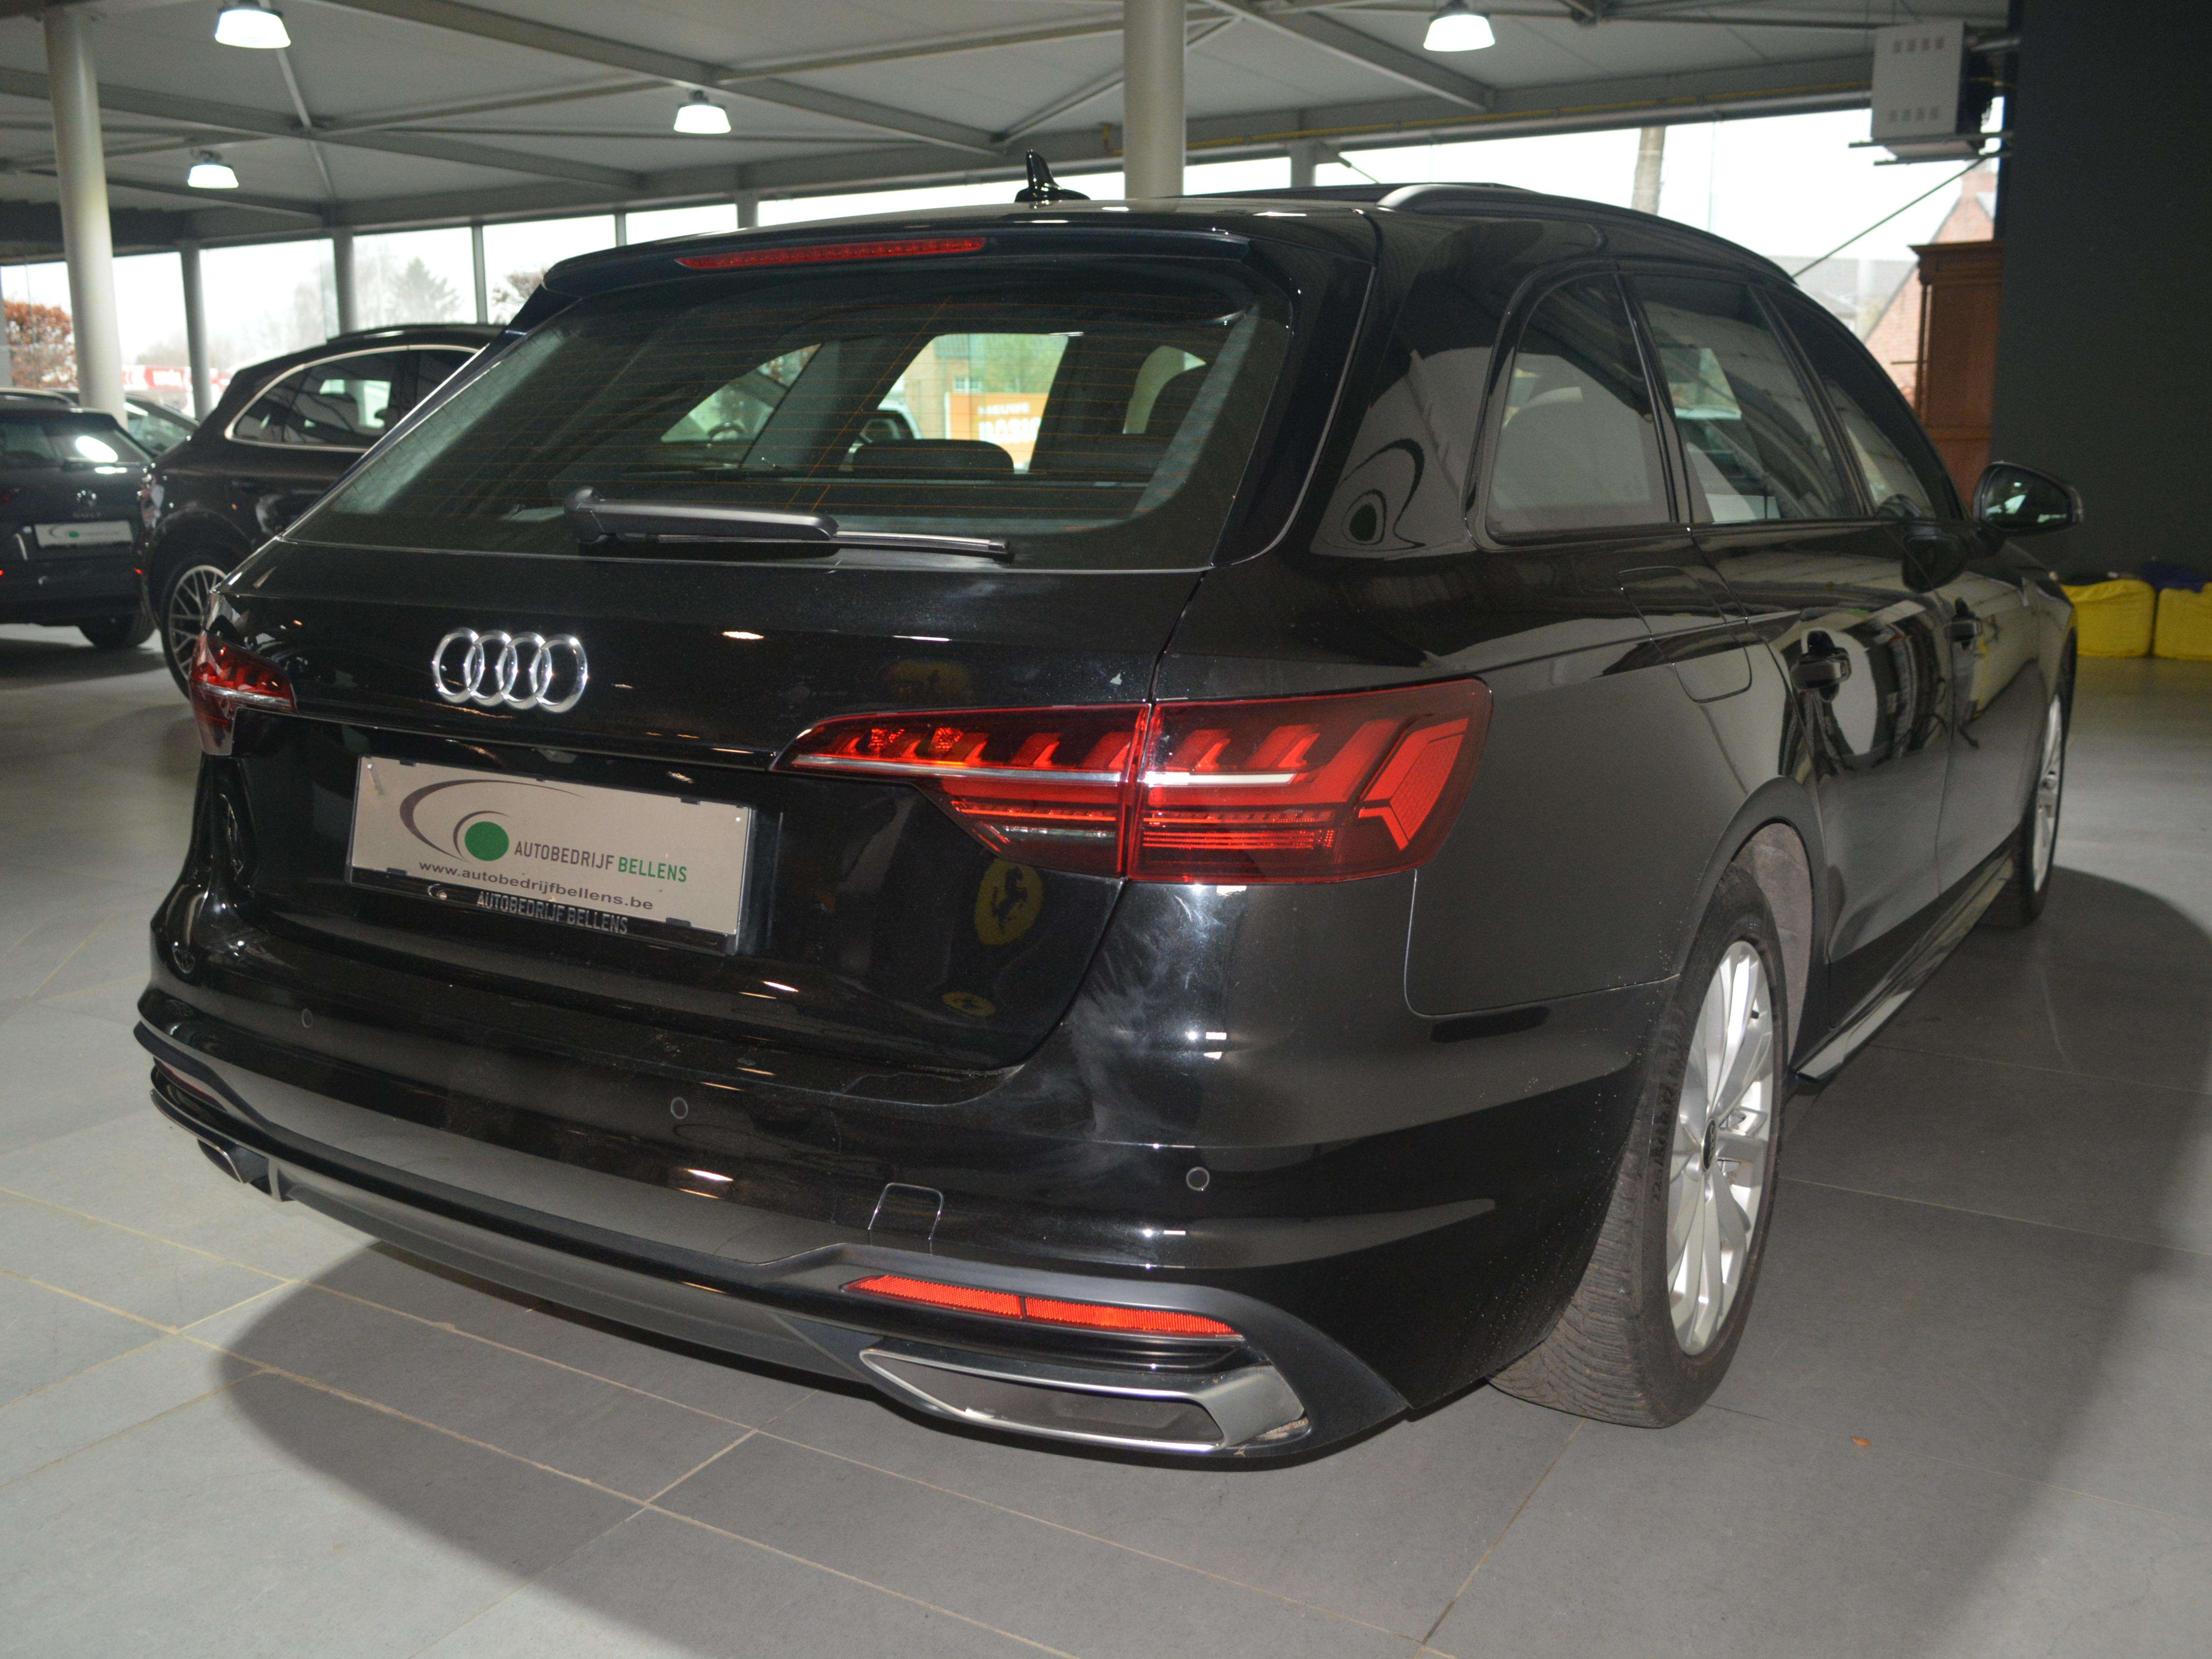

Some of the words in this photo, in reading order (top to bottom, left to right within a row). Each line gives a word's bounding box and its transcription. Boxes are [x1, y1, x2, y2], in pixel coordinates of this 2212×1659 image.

[514, 841, 615, 870] AUTOBEDRIJF
[618, 856, 688, 883] BELLENS
[419, 862, 654, 910] www.autobedrijfbellens.be
[477, 891, 566, 922] AUTOBEDRIJF
[567, 906, 629, 935] BELLENS
